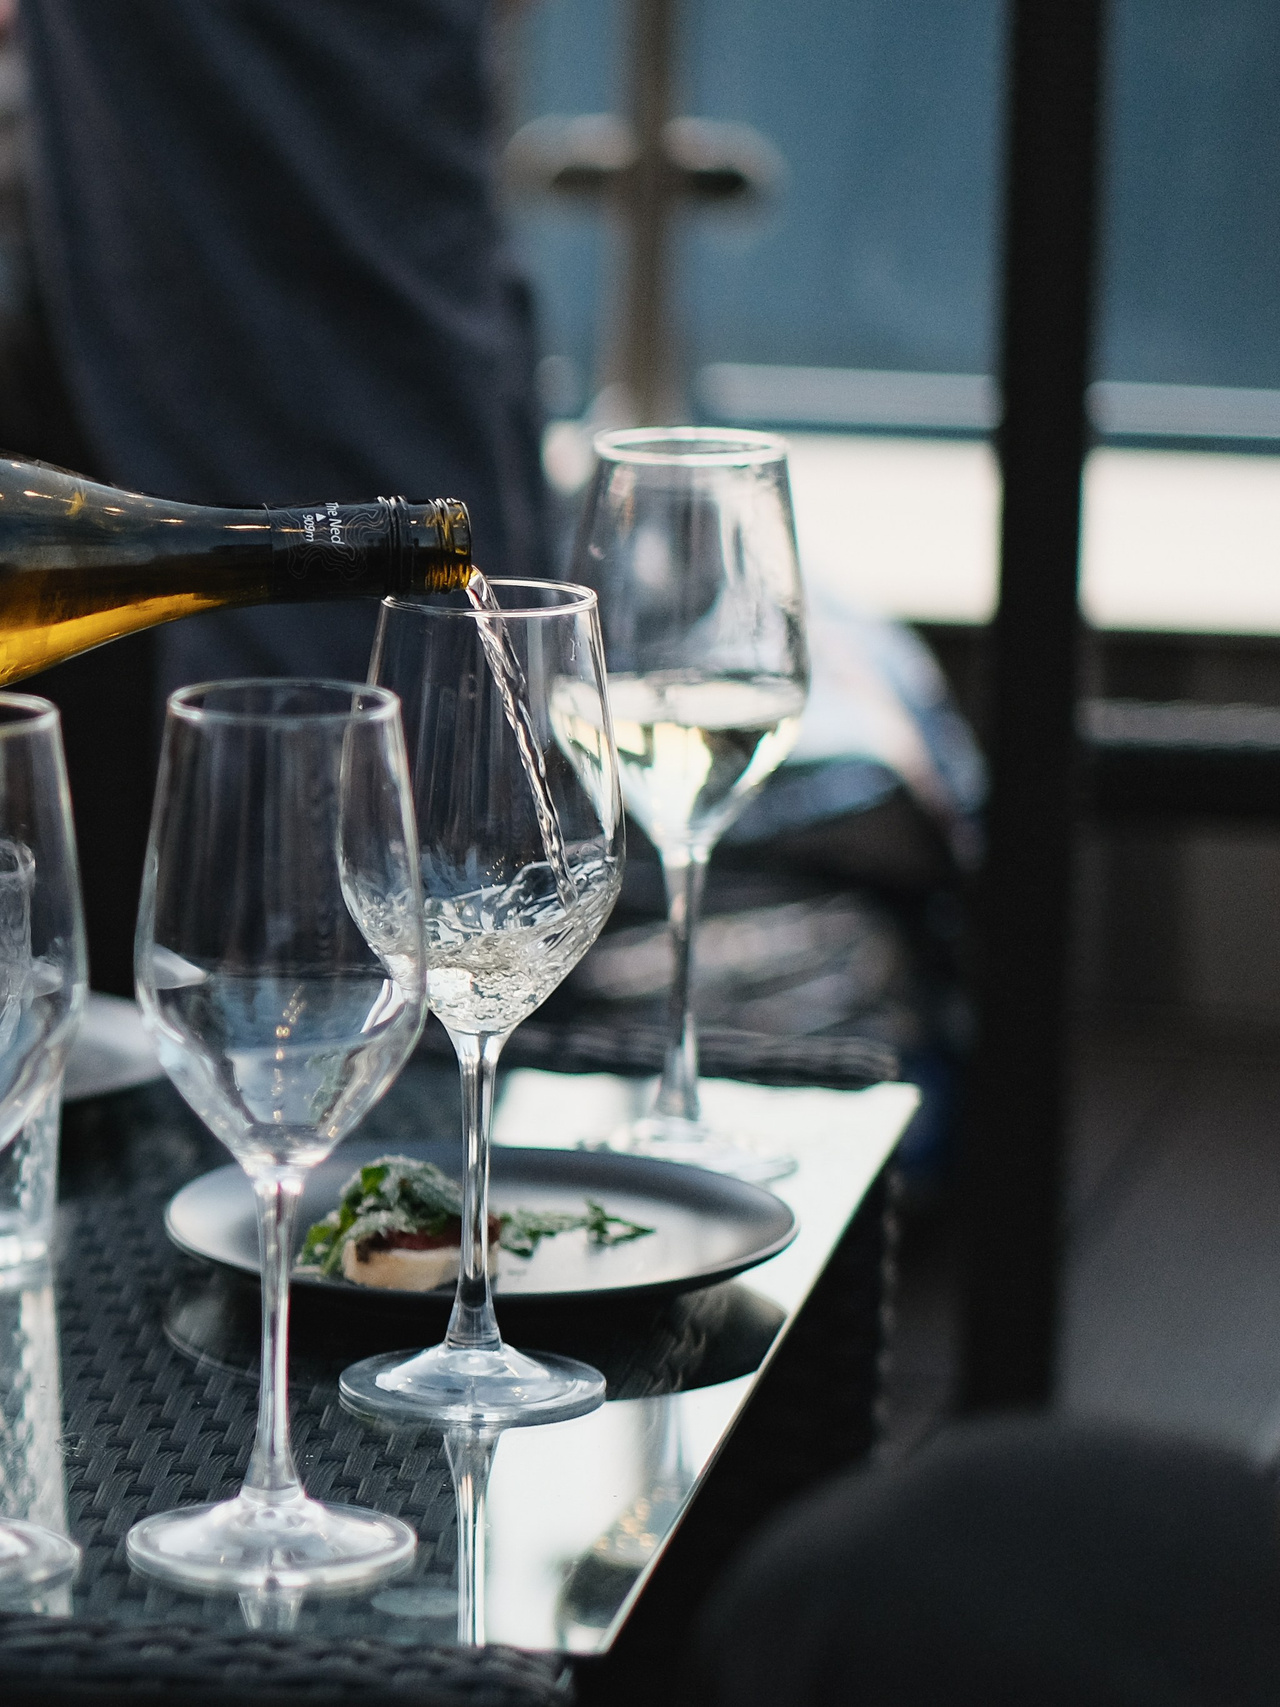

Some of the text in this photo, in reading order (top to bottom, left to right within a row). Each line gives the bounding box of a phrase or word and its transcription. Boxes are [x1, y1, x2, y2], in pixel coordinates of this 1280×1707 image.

[302, 514, 316, 542] 909m
[325, 502, 346, 545] The Ned
